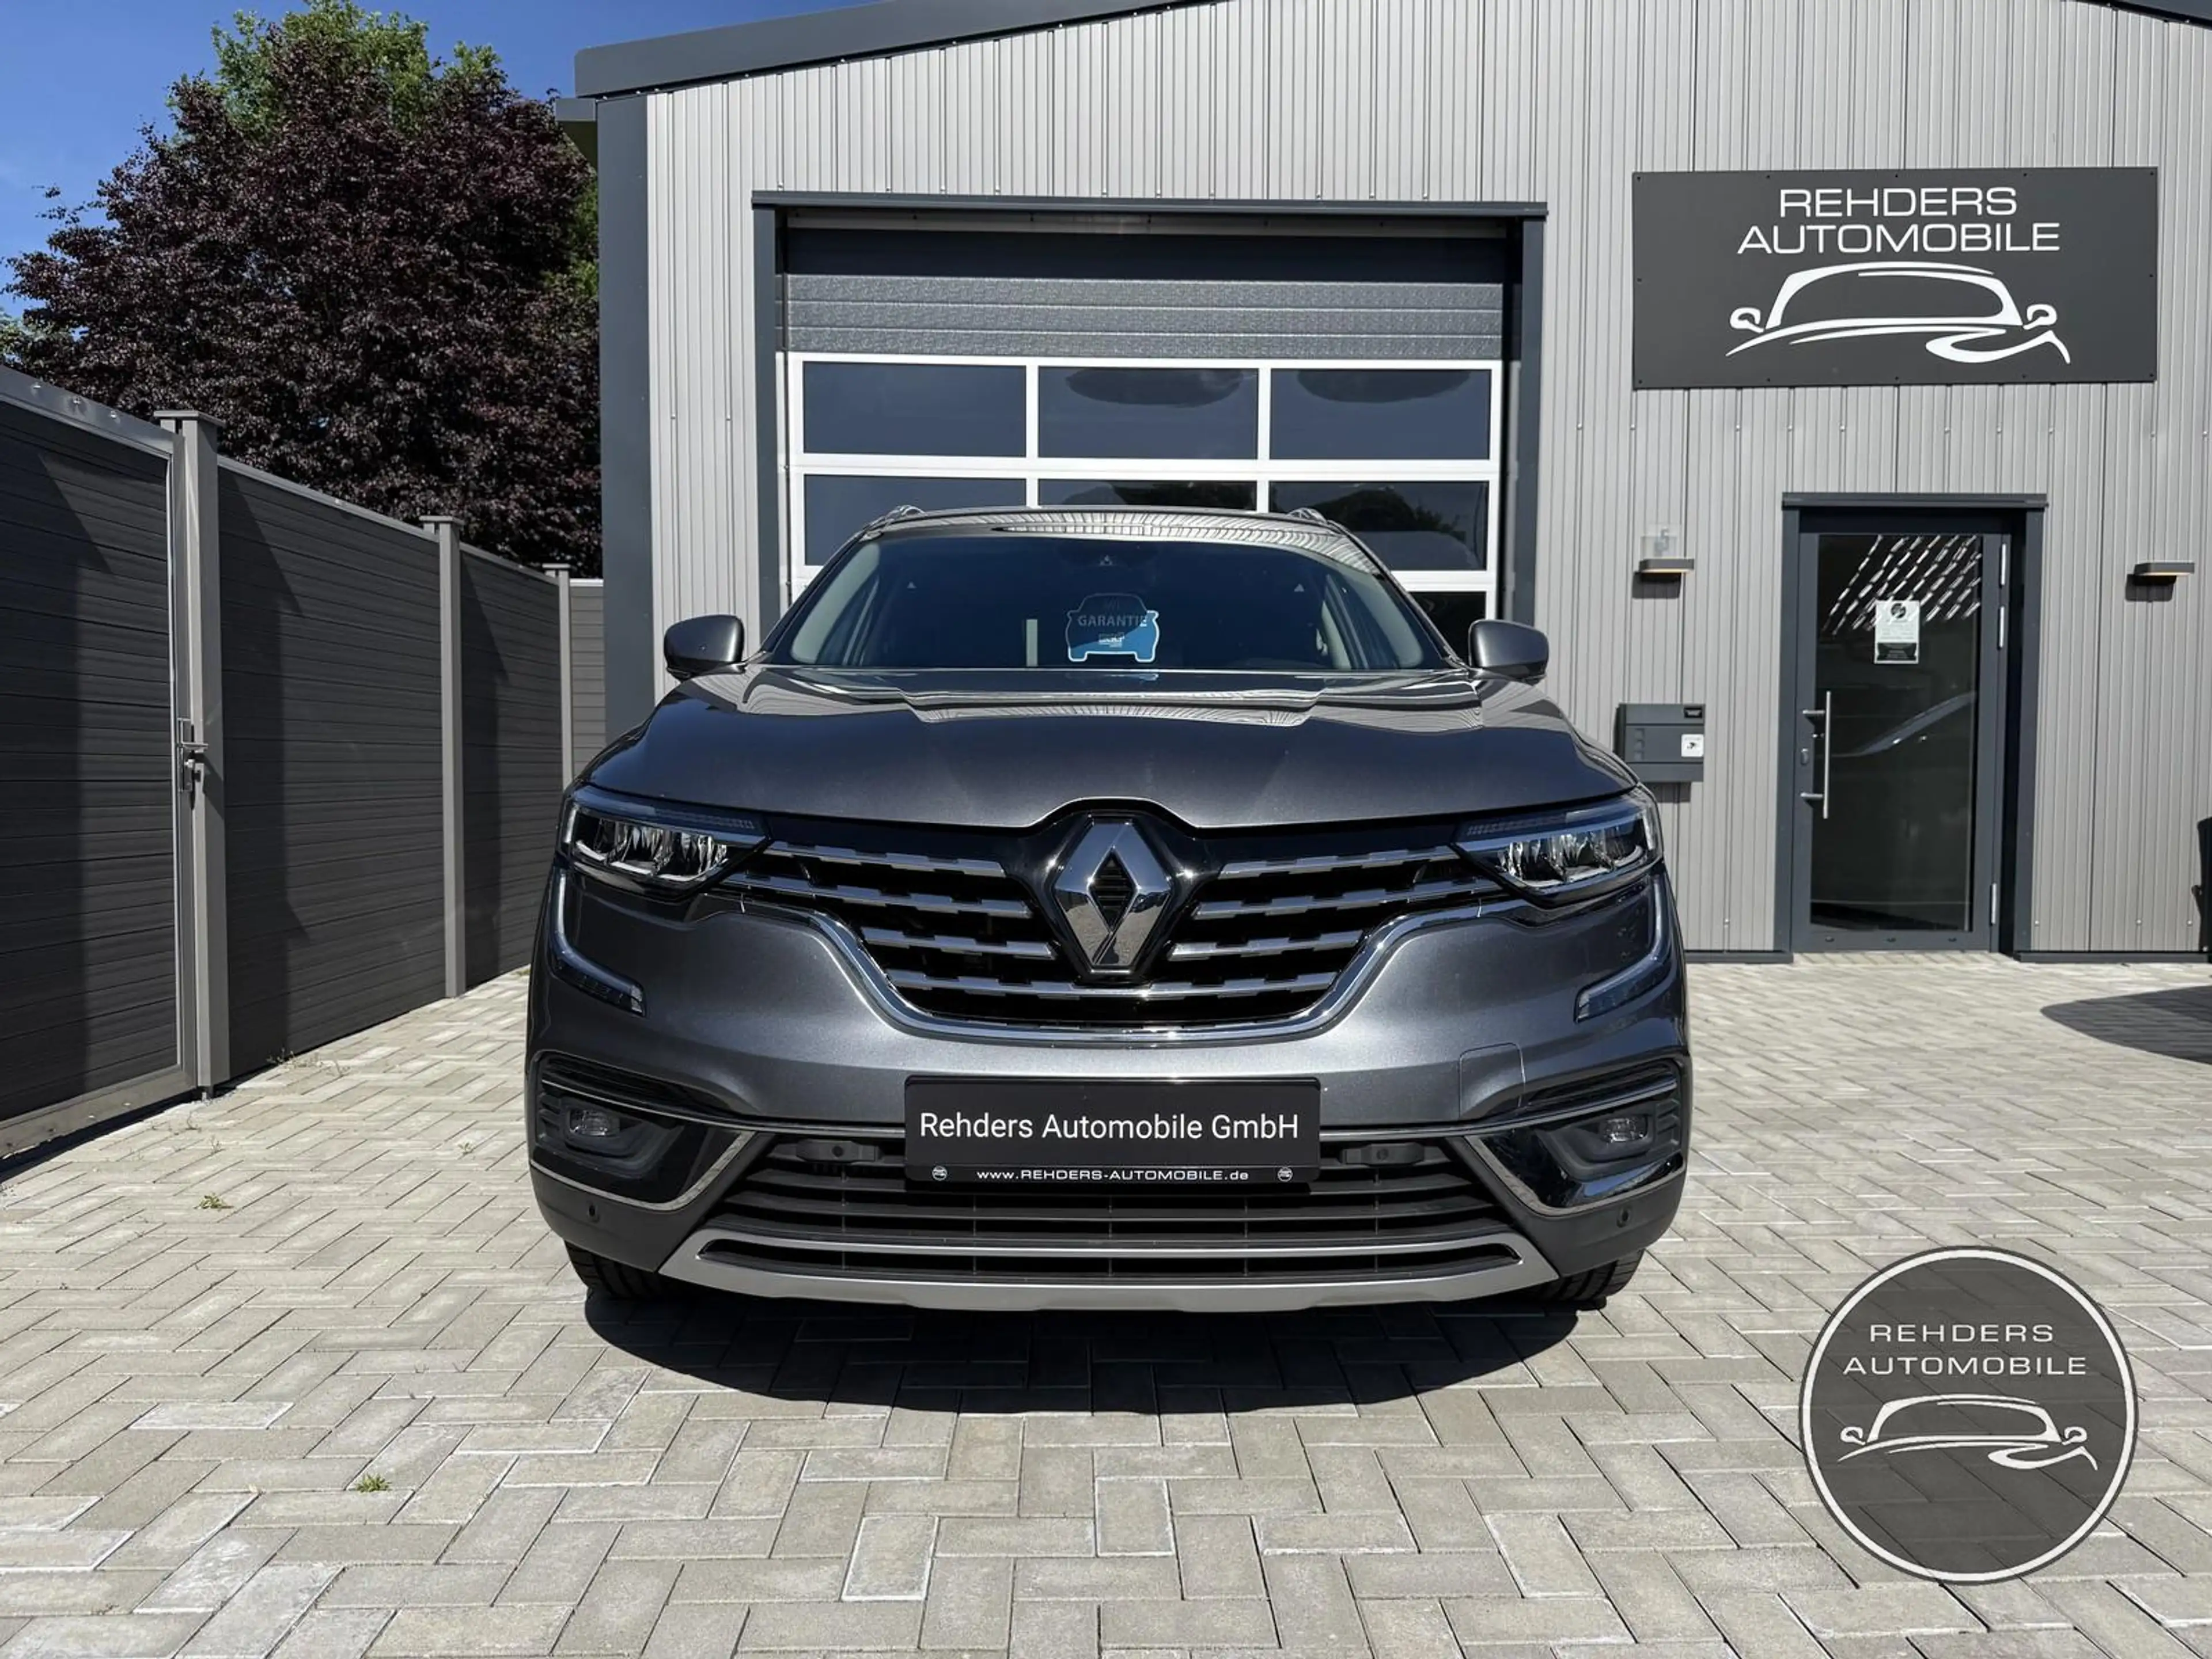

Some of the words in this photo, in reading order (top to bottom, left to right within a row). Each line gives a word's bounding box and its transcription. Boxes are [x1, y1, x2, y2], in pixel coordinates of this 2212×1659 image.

[1779, 186, 2017, 218] REHDERS
[1736, 222, 2061, 255] AUTOMOBILE
[1078, 614, 1148, 627] GARANTIE
[921, 1111, 1034, 1139] Rehders
[1041, 1112, 1203, 1140] Automobile
[1211, 1113, 1299, 1139] GmbH
[976, 1169, 1250, 1181] www.REHDERS-AUTOMOBILE.de
